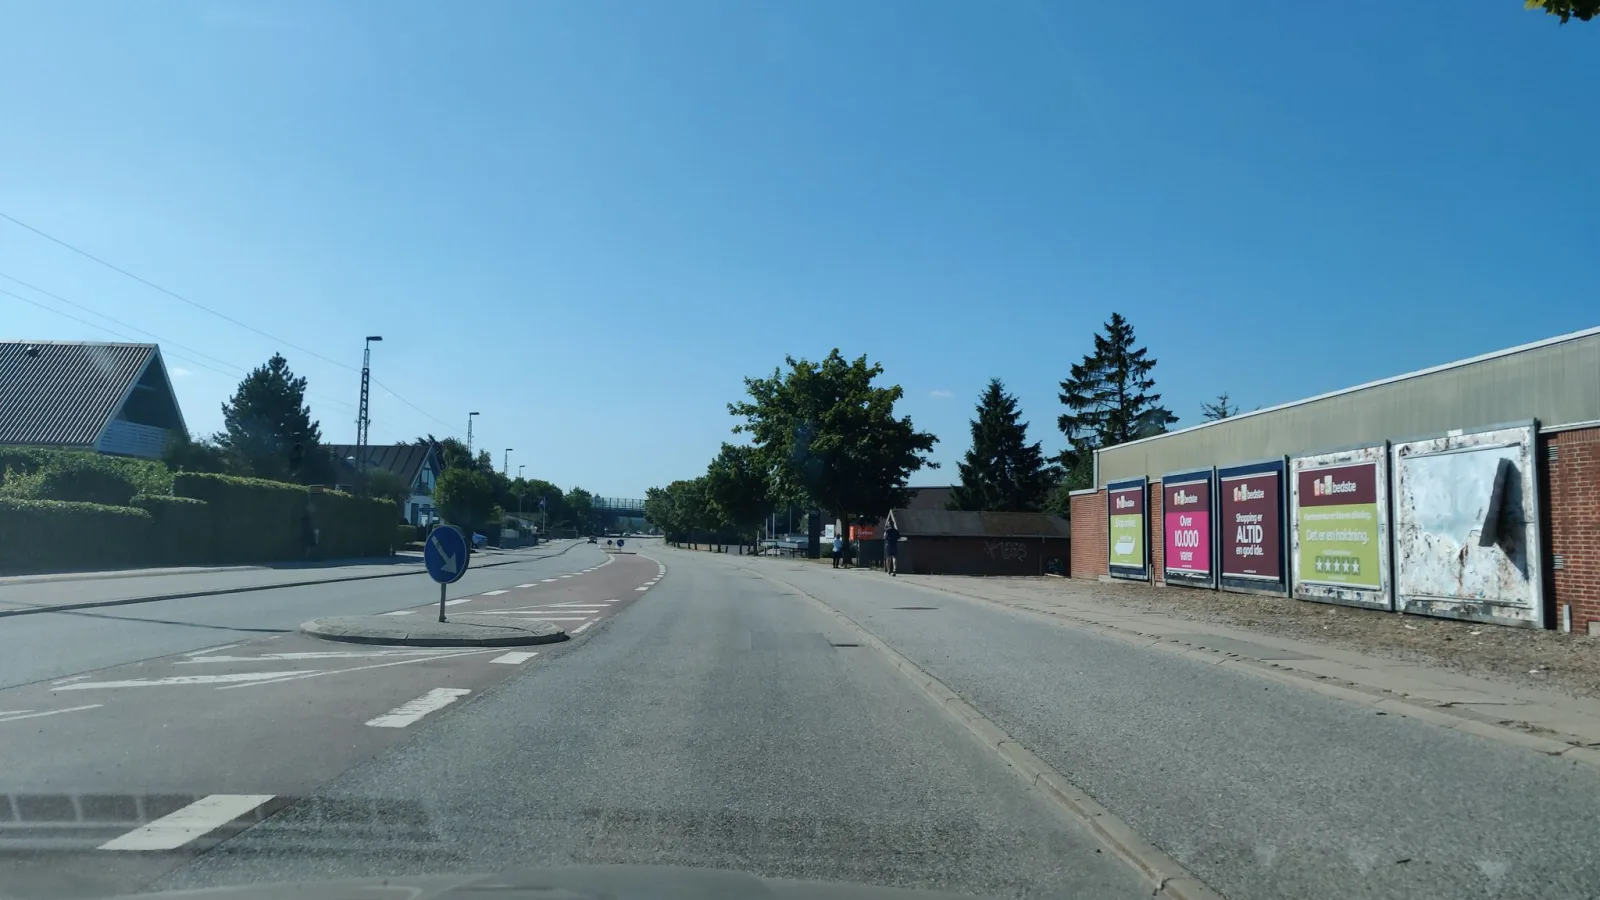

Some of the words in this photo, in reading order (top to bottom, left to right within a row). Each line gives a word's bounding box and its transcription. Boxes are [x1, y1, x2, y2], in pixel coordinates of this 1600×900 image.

[1180, 515, 1192, 526] Over
[1235, 512, 1257, 524] Shopping
[1174, 530, 1199, 547] 10.000
[1235, 525, 1263, 543] ALTID
[1306, 529, 1318, 541] Det
[1318, 531, 1326, 541] er
[1326, 531, 1335, 541] en
[1180, 551, 1193, 561] varer
[1235, 546, 1242, 555] en
[1243, 544, 1253, 557] god
